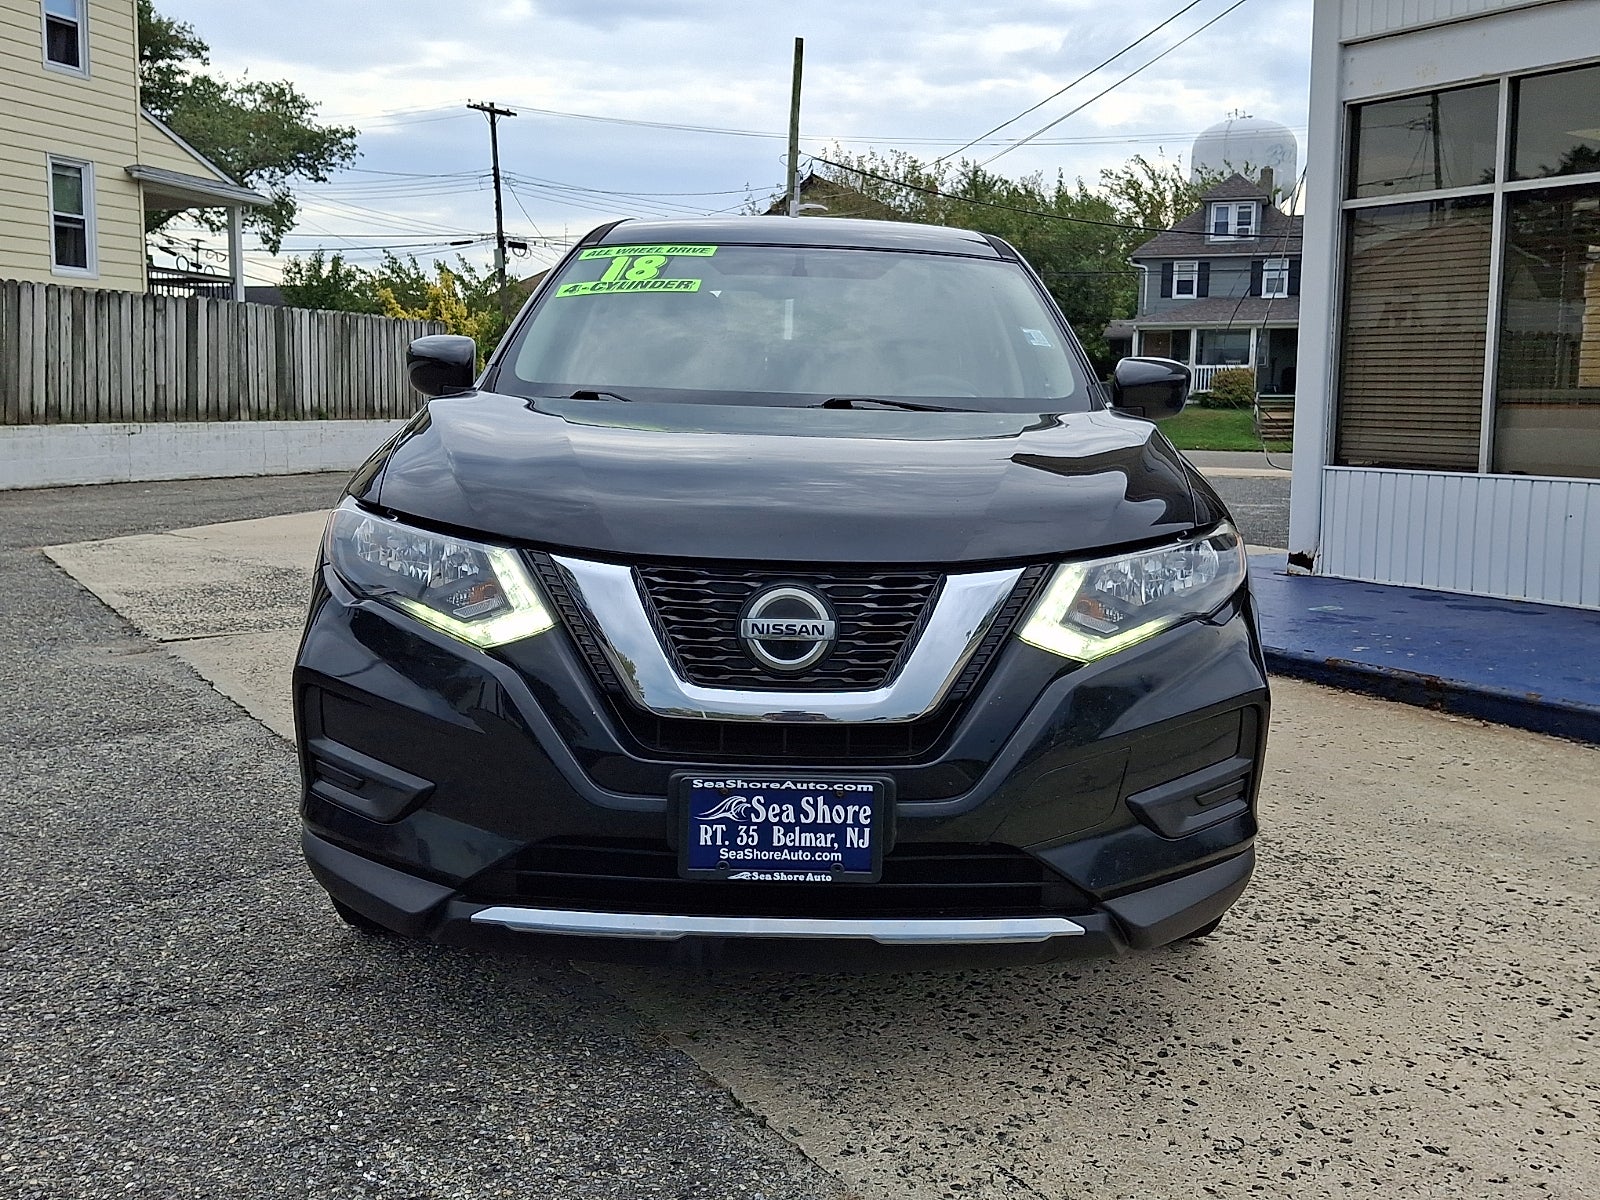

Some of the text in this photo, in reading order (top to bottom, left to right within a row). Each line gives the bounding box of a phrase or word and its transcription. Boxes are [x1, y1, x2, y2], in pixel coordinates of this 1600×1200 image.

[585, 246, 711, 258] ALL WHEEL DRIVE
[600, 255, 668, 282] 18
[563, 280, 697, 294] 4-CYLINDER
[751, 623, 825, 636] NISSAN
[693, 780, 873, 791] SeaShoreAuto.com
[751, 795, 872, 825] Sea Shore
[699, 824, 870, 850] RT. 35 Belmar, NJ
[719, 847, 842, 861] SeaShoreAuto.com
[751, 872, 832, 882] Sea Shore Auto
